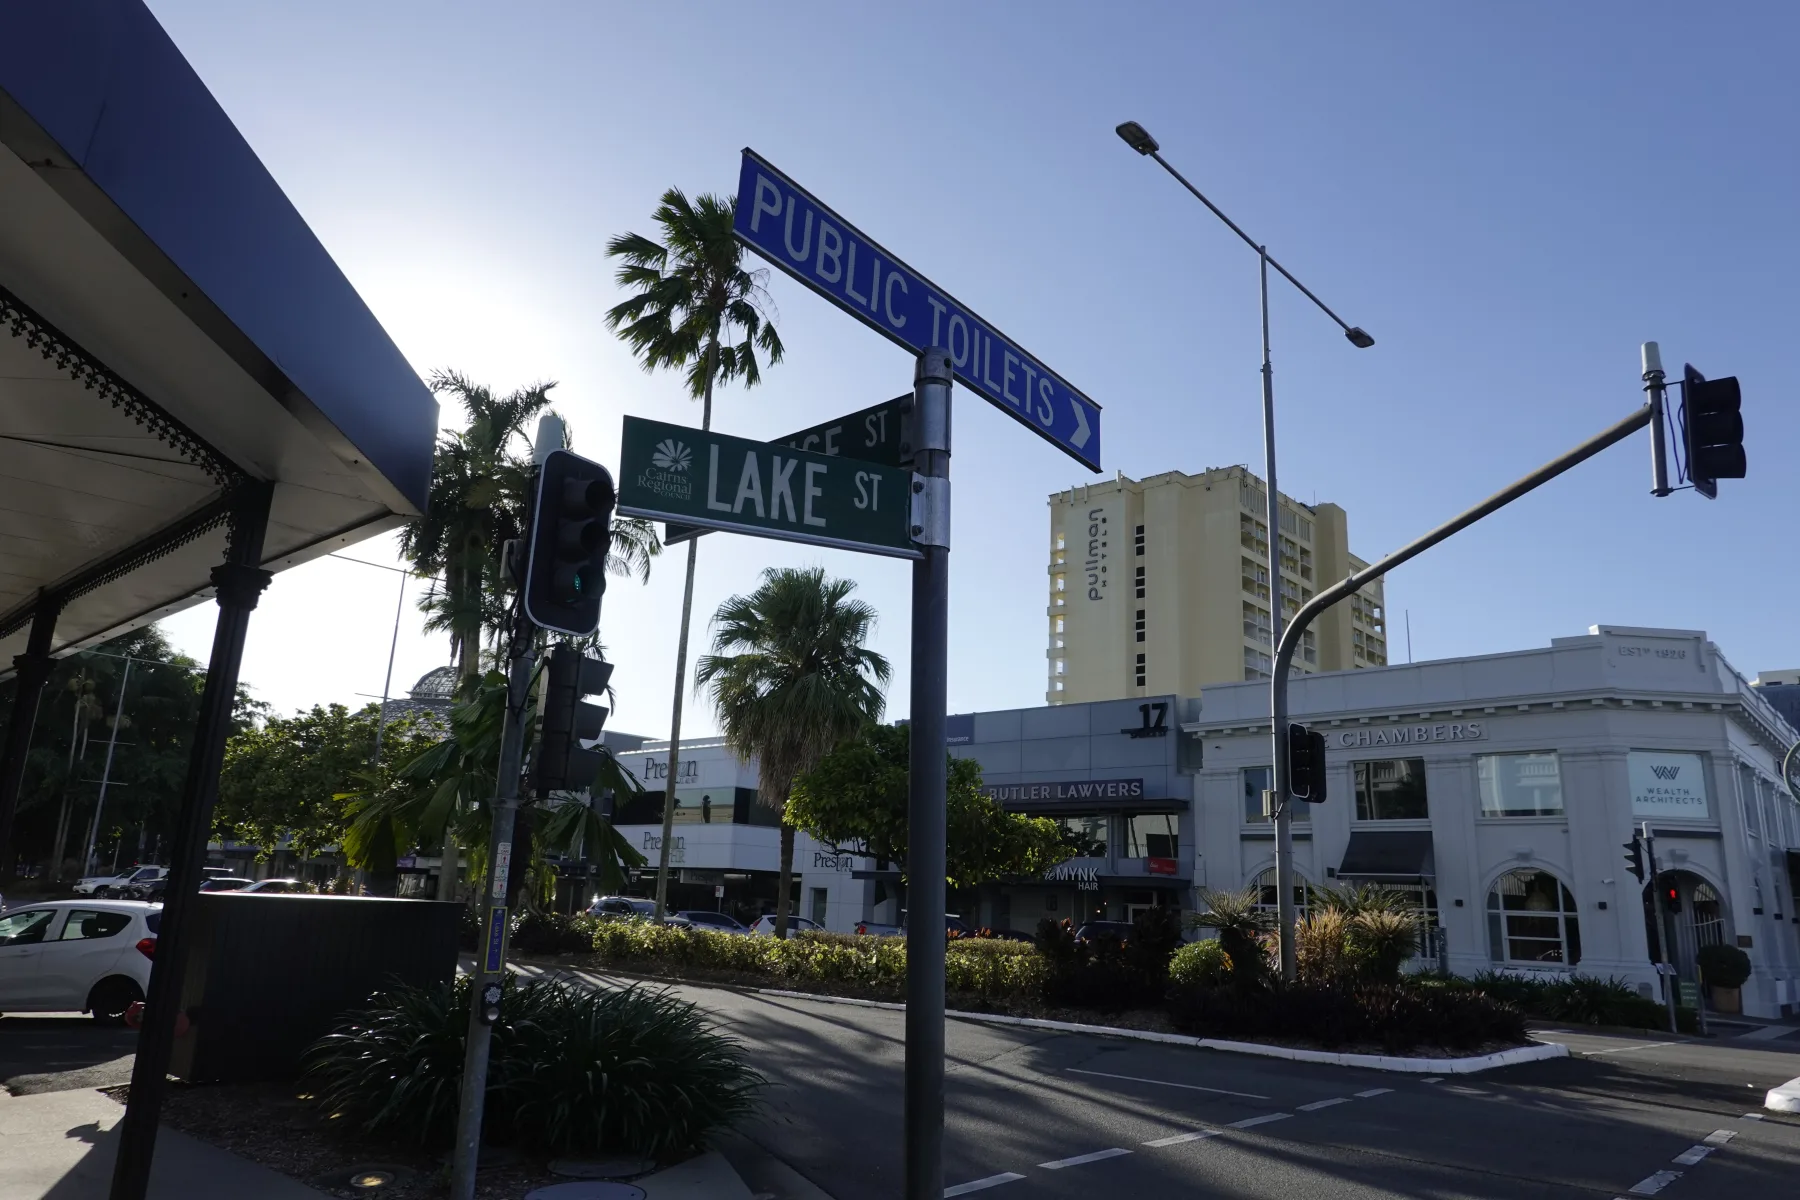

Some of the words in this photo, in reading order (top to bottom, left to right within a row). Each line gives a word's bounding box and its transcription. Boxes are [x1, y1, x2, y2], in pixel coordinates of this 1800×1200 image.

[750, 173, 908, 330] PUBLIC
[927, 296, 1055, 428] TOILETS
[864, 410, 889, 448] ST
[637, 475, 692, 495] Regional
[645, 467, 688, 484] Cairns
[706, 443, 828, 528] LAKE
[853, 471, 883, 511] ST
[1085, 508, 1104, 601] pullman
[1138, 702, 1169, 729] 17
[1339, 722, 1482, 747] CHAMBERS
[644, 757, 698, 781] Preon
[989, 785, 1050, 801] BUTLER
[1057, 782, 1142, 799] LAWYERS
[1635, 796, 1703, 805] ARCHITECTS
[1646, 788, 1690, 796] WEALTH
[643, 832, 686, 850] Preon
[813, 852, 854, 872] Preston
[1077, 882, 1099, 891] HAIR
